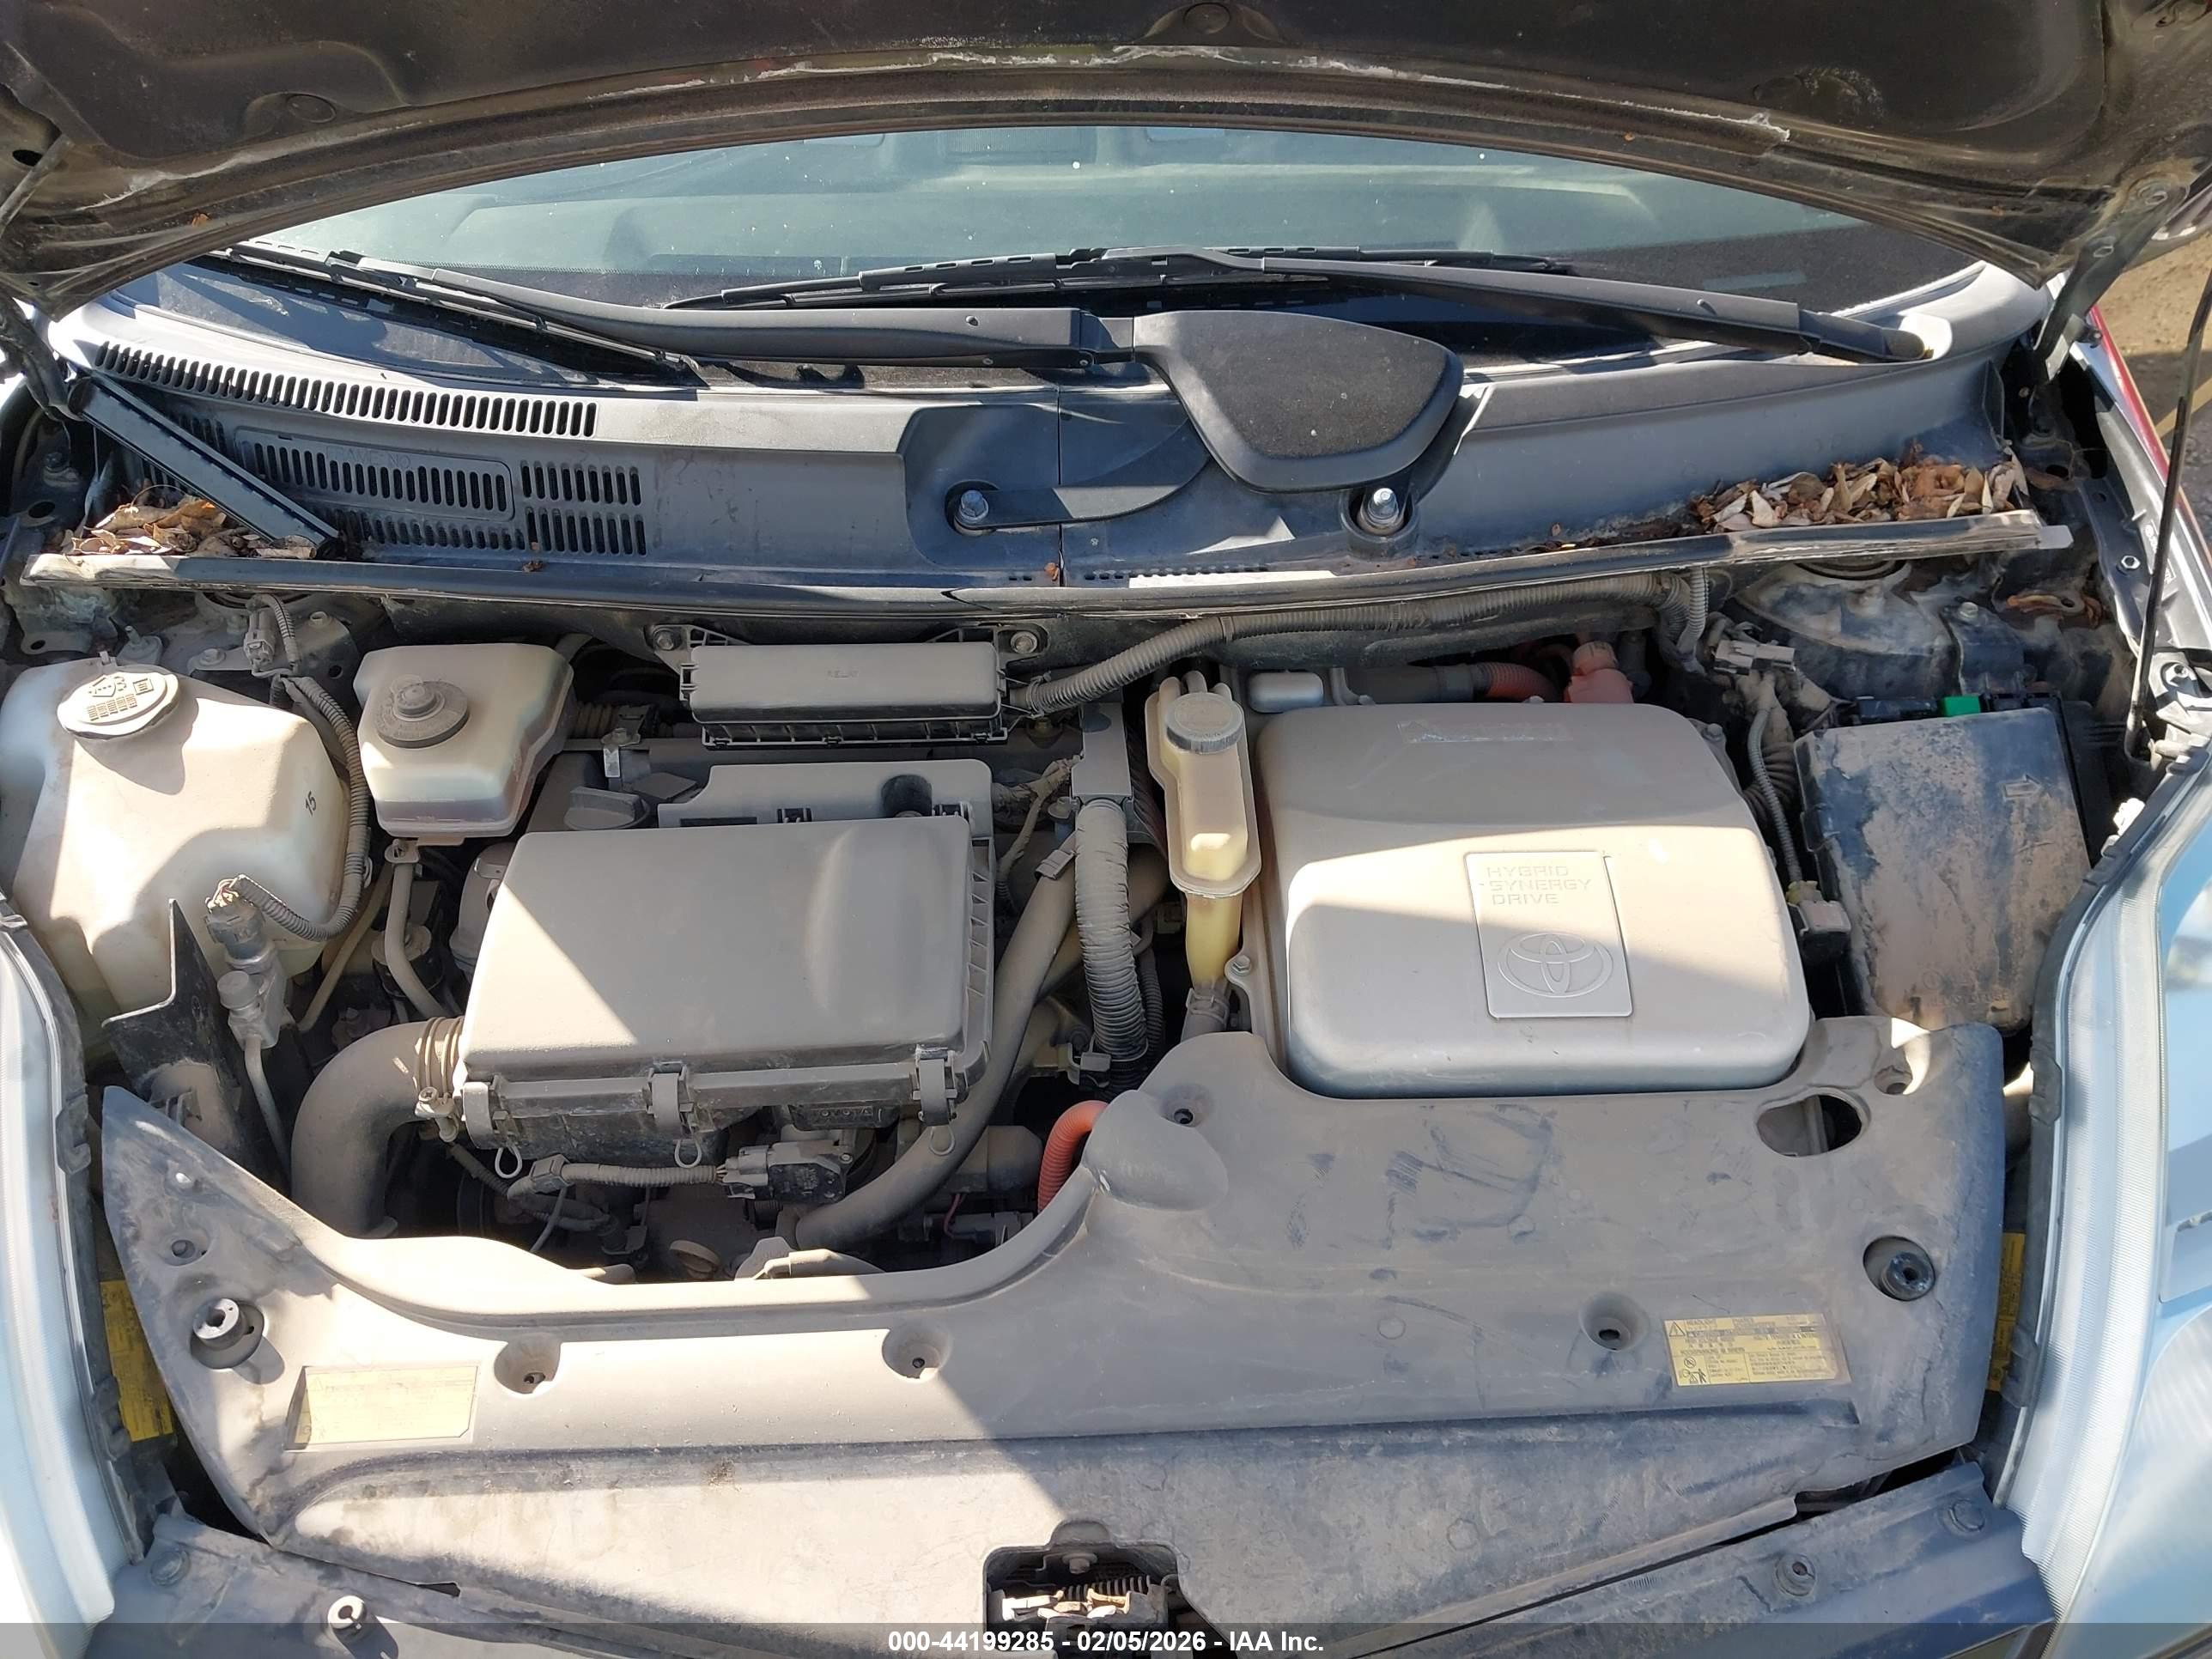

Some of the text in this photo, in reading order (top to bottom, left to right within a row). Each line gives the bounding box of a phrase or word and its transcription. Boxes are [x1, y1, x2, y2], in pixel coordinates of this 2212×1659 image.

[1486, 866, 1569, 878] HYBRID
[1489, 878, 1592, 891] SYNERGY
[1492, 893, 1560, 905] DRIVE
